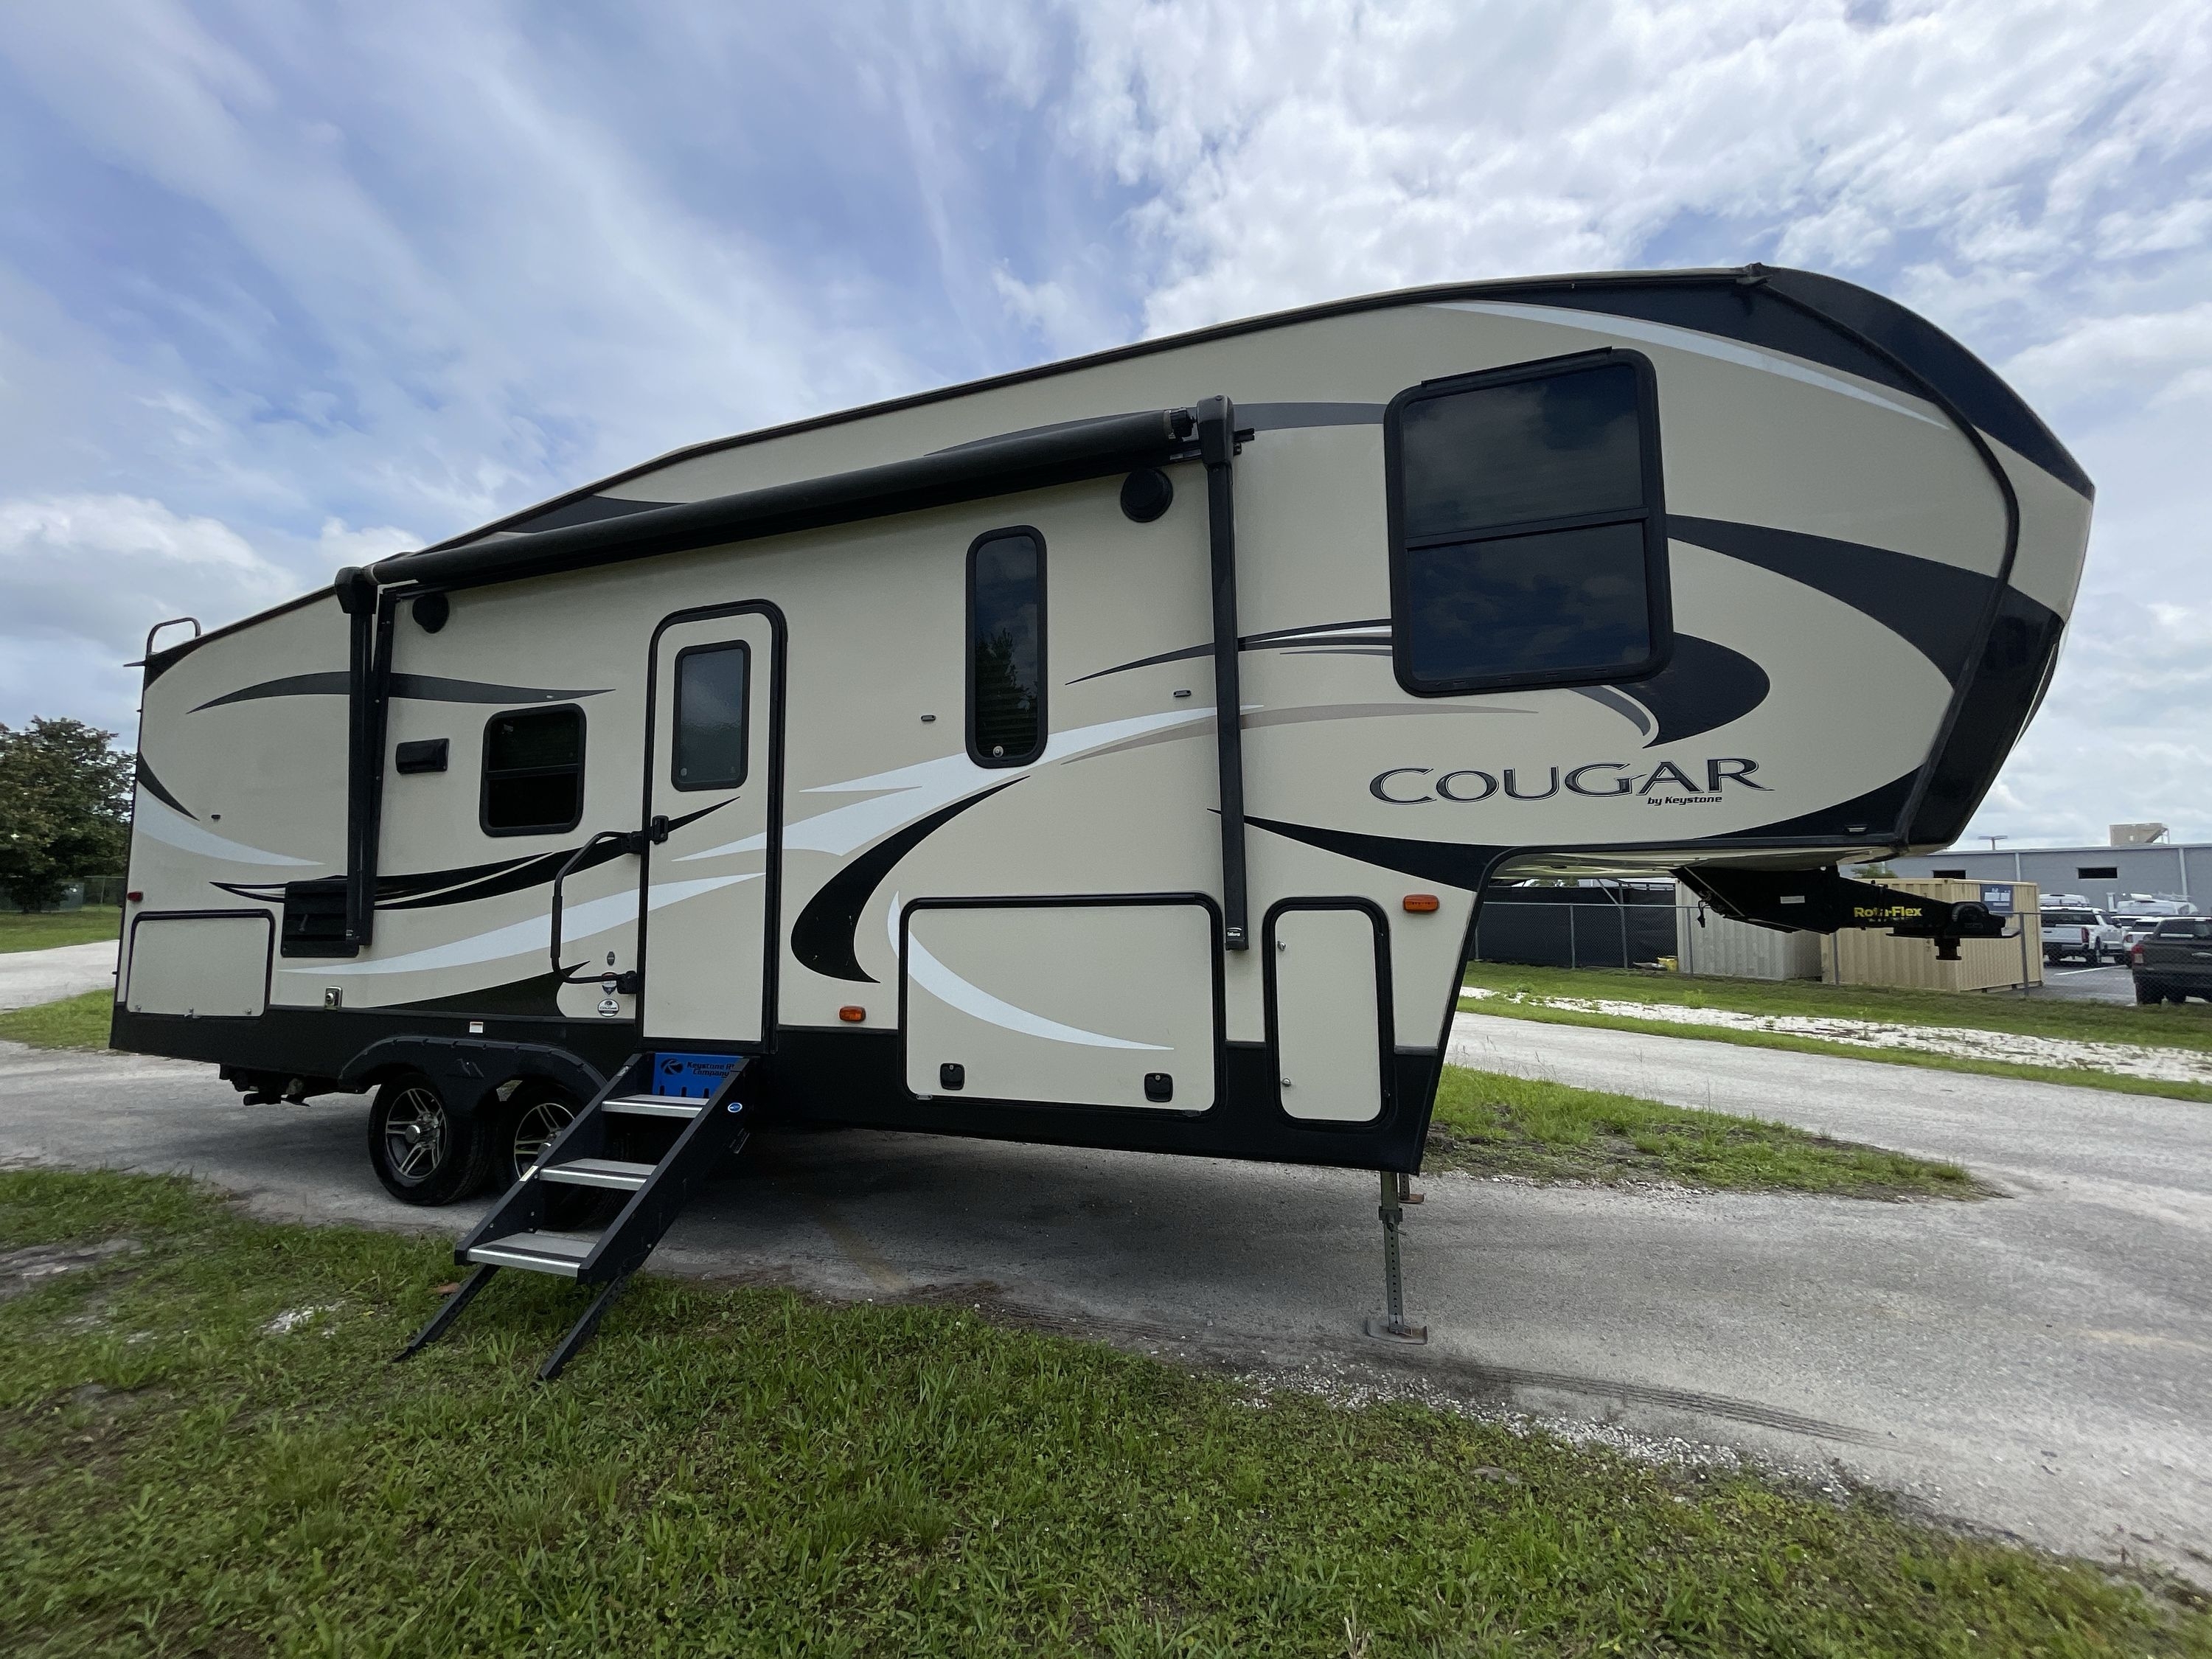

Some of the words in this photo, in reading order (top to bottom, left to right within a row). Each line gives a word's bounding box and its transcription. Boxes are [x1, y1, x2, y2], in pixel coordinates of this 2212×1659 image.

[1368, 757, 1775, 804] COUGAR
[1647, 797, 1662, 806] by
[1665, 796, 1722, 805] Keystone
[687, 1062, 725, 1070] Keystone
[692, 1068, 730, 1078] Company
